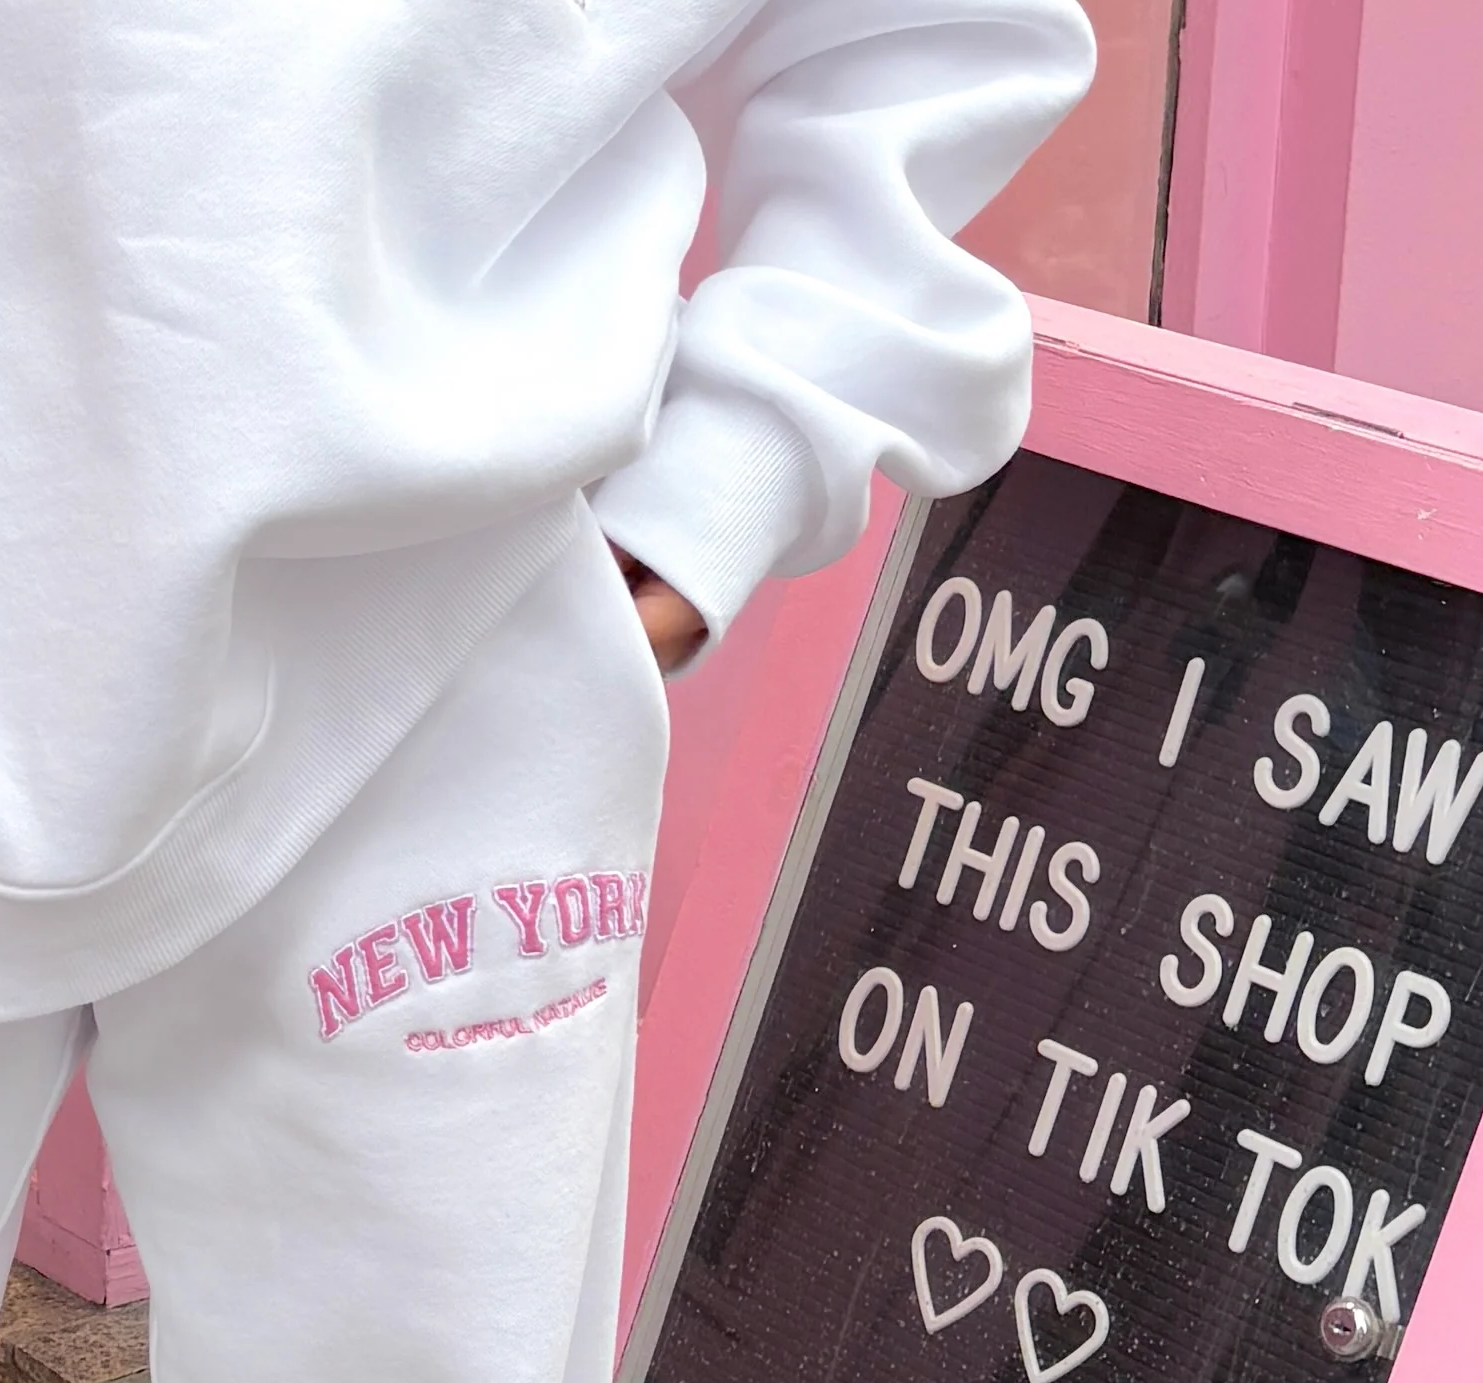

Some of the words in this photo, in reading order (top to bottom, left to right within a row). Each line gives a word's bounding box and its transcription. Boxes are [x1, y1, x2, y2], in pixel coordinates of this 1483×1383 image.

[917, 576, 1109, 728] OMG
[1158, 657, 1205, 768] I
[1254, 693, 1483, 866] SAW
[308, 893, 477, 1043] NEW
[404, 1016, 534, 1052] COLORFUL
[897, 777, 1101, 953] THIS
[1159, 893, 1452, 1087] SHOP
[837, 966, 974, 1109] ON
[1027, 1038, 1191, 1215] TIK
[1228, 1128, 1426, 1322] TOK
